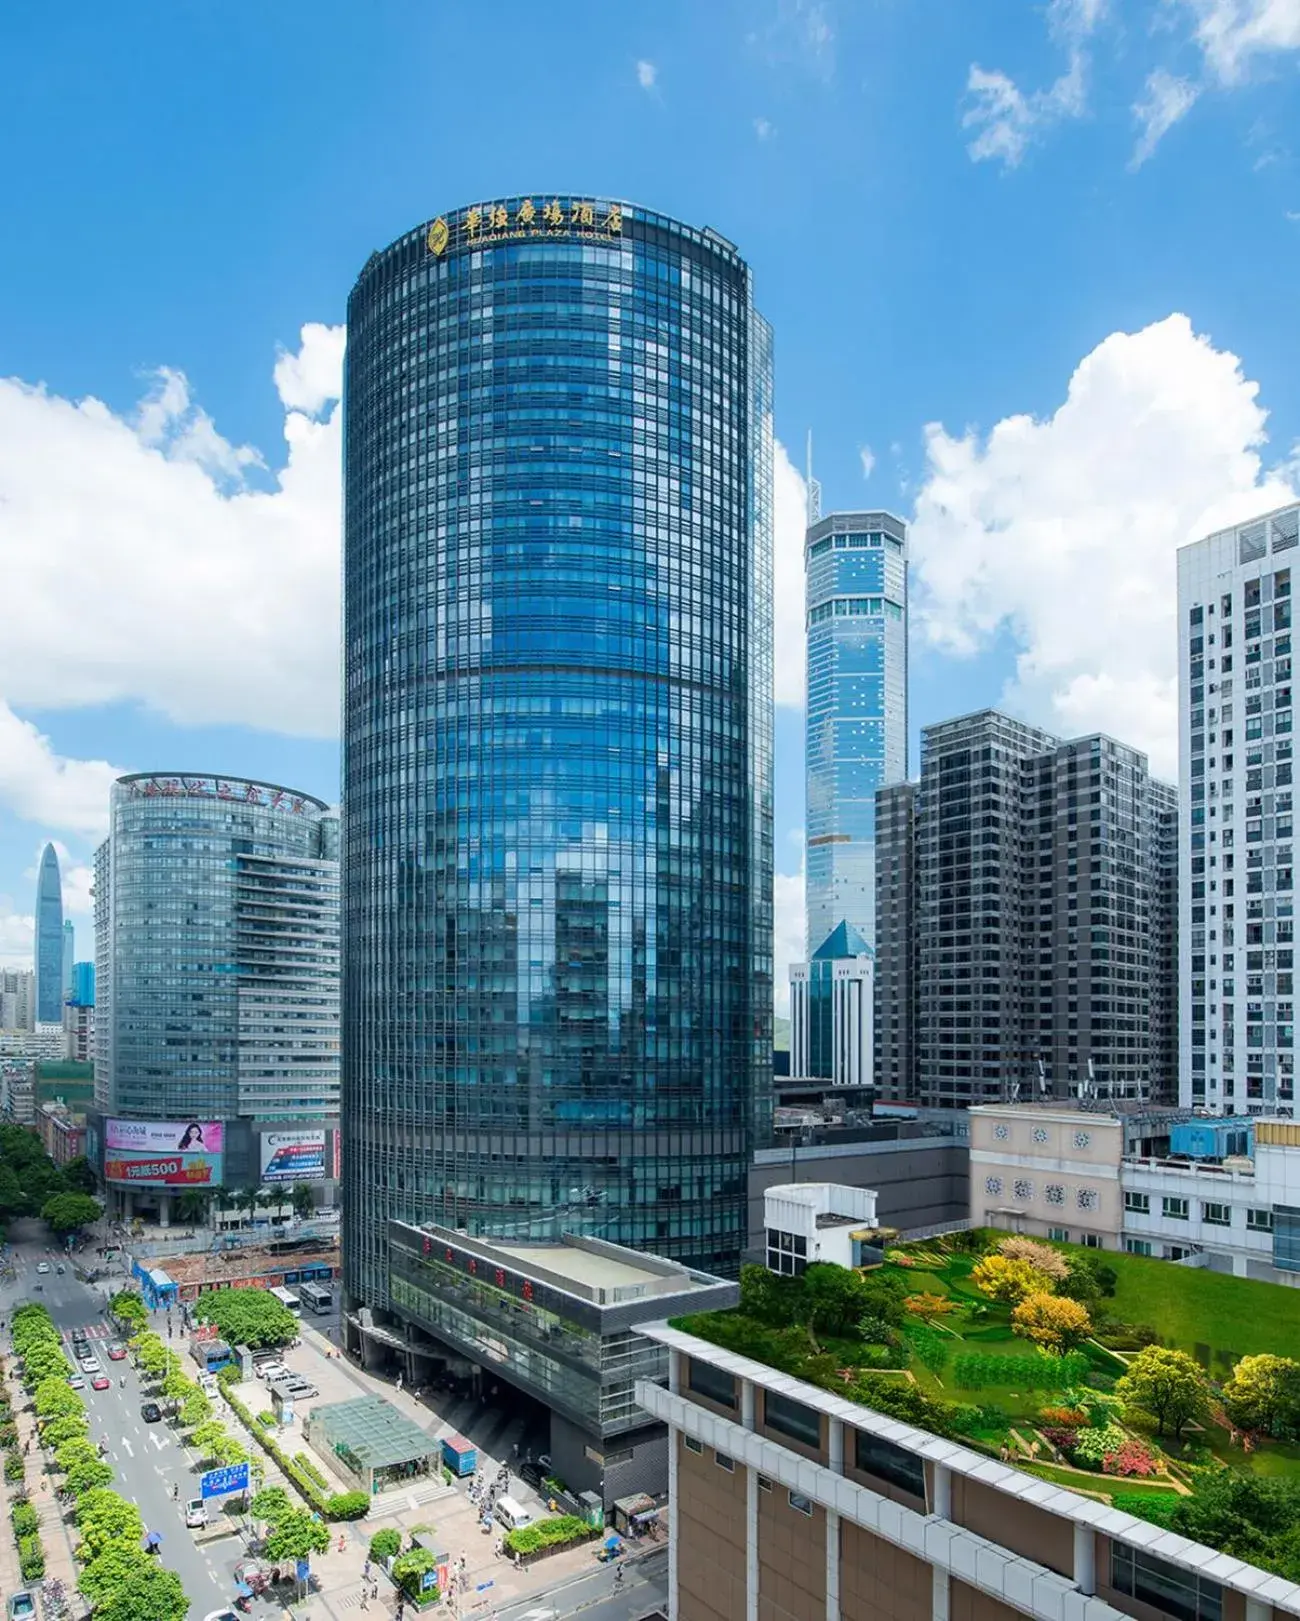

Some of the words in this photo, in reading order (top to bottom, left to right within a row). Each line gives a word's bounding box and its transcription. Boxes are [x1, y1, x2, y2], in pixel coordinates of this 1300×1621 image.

[466, 230, 526, 246] HUAQIANG
[530, 228, 571, 237] PLAZA
[576, 230, 613, 241] HOTEL
